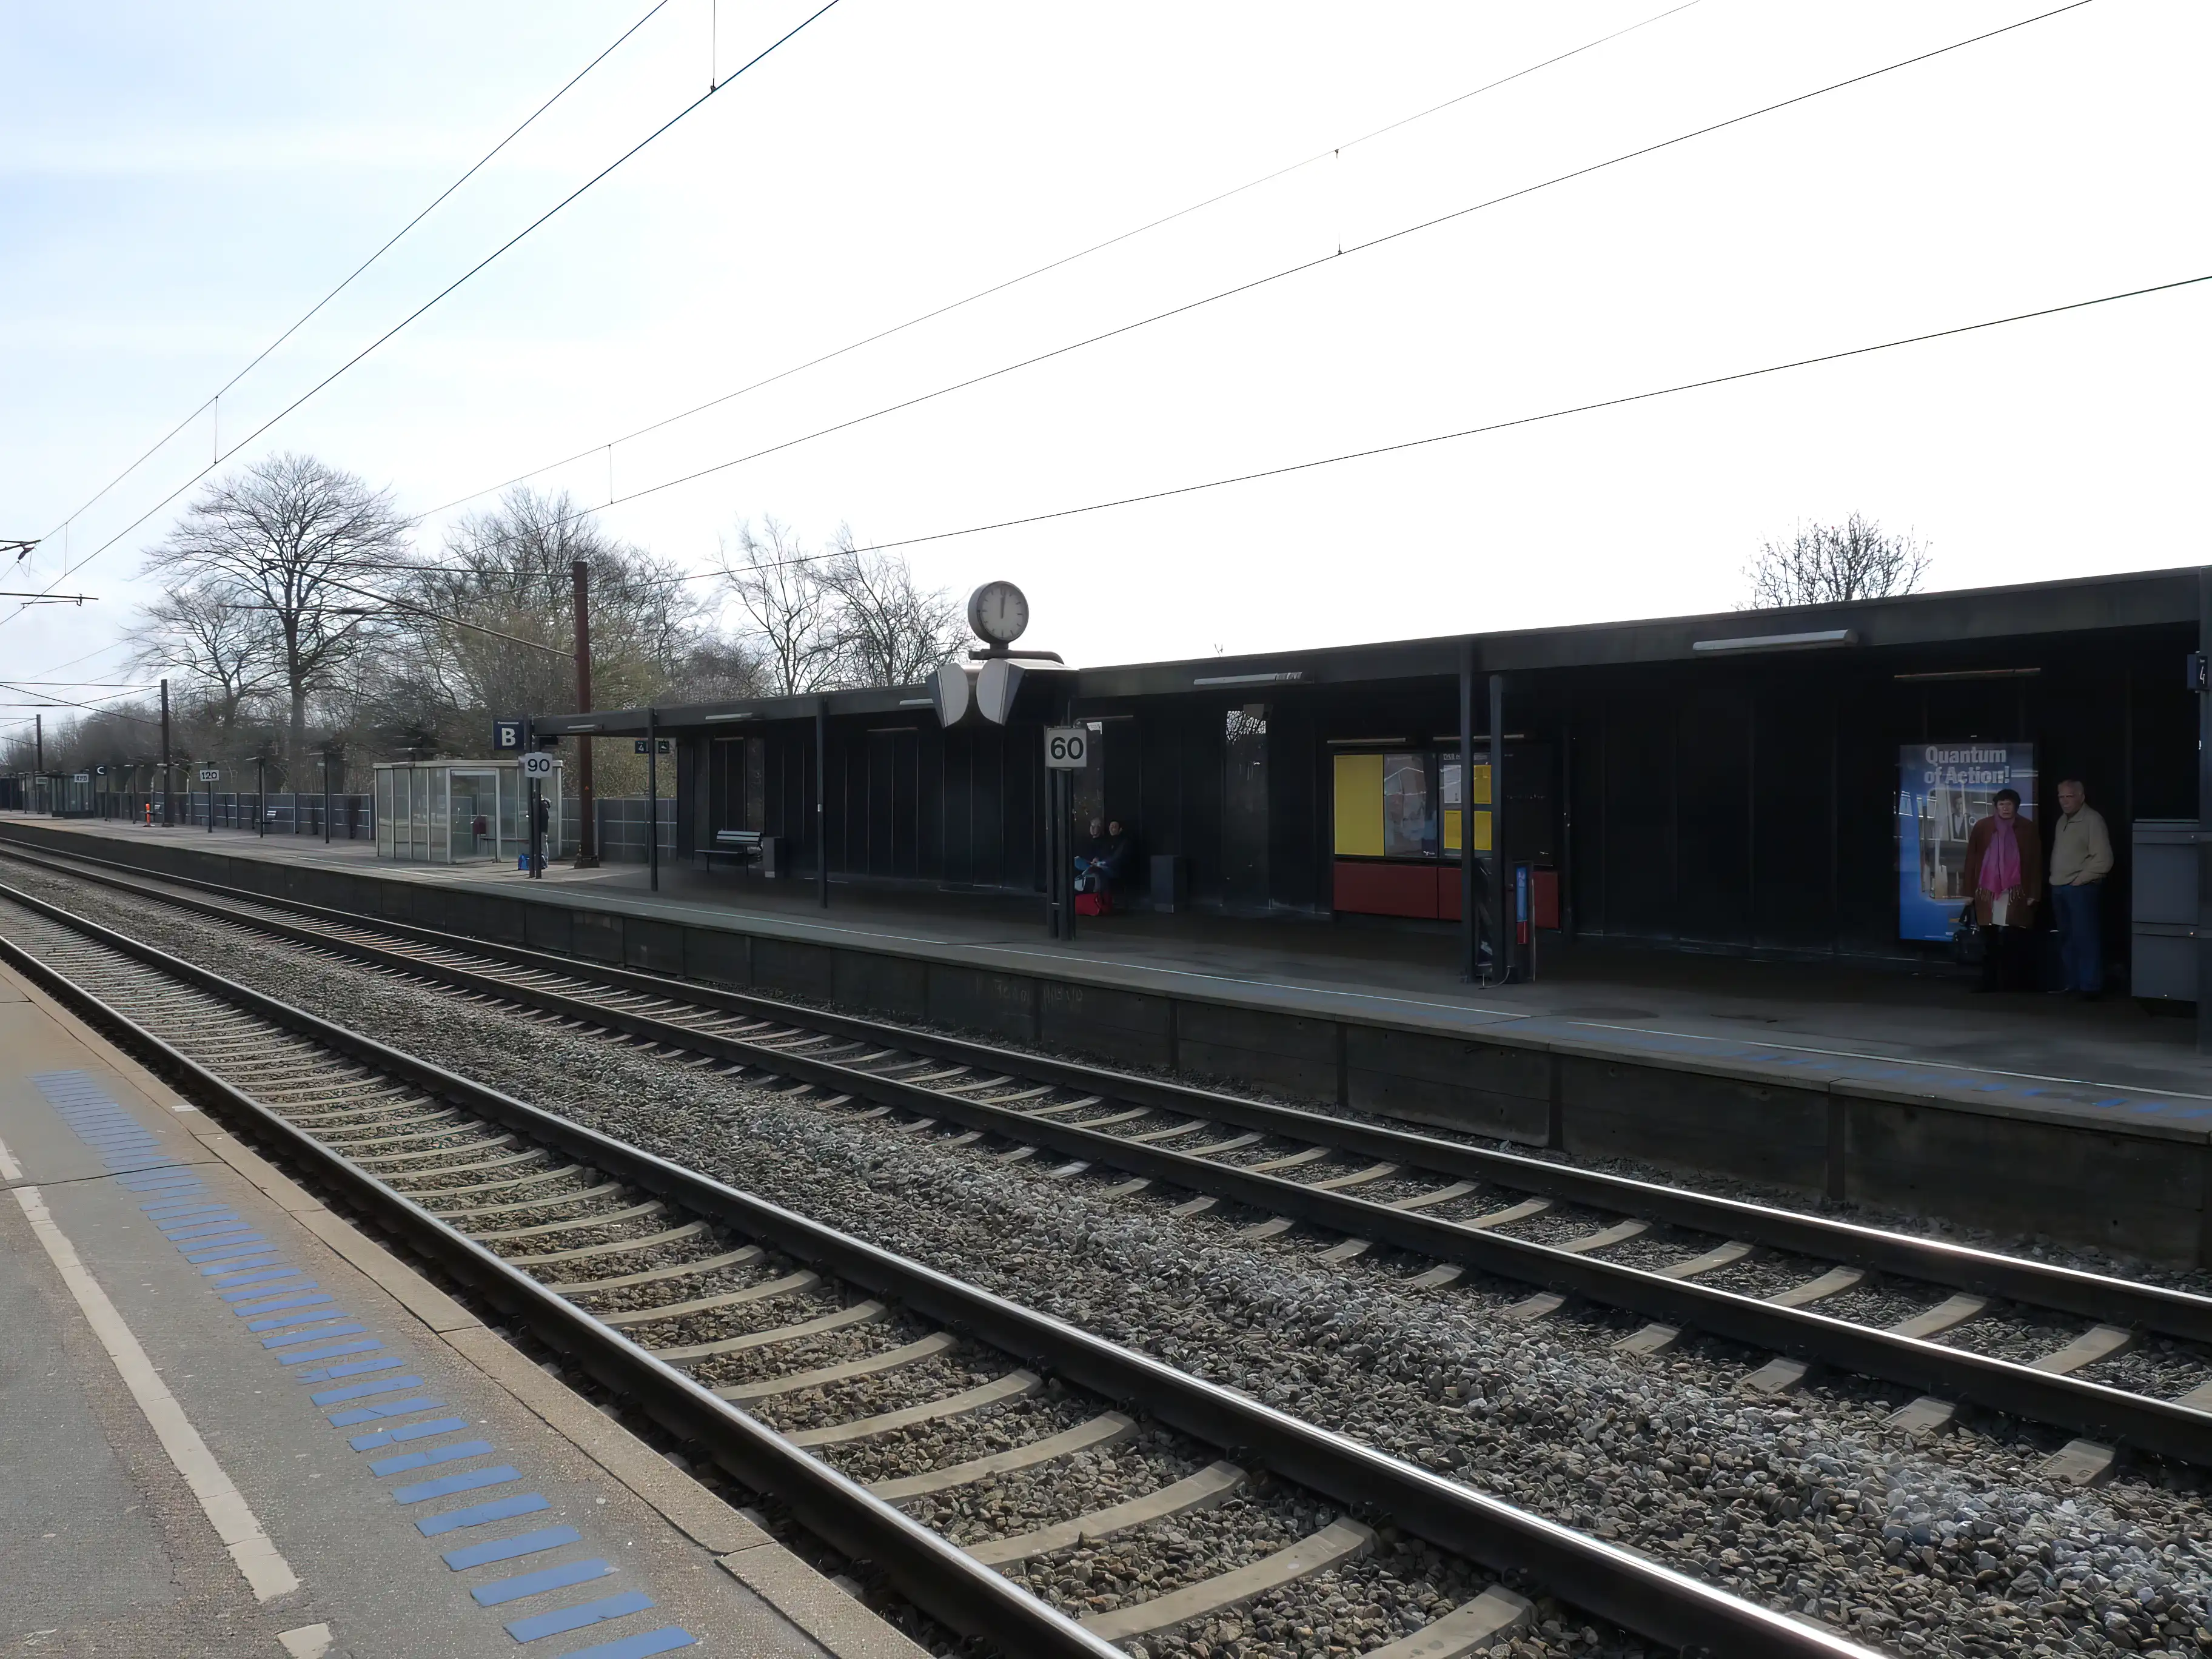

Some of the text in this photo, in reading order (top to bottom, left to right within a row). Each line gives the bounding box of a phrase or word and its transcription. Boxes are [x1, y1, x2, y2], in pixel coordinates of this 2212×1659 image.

[501, 728, 516, 746] B
[1051, 737, 1084, 760] 60
[1925, 746, 2006, 766] Quantum
[528, 759, 551, 772] 90
[1924, 766, 2010, 783] of Action!
